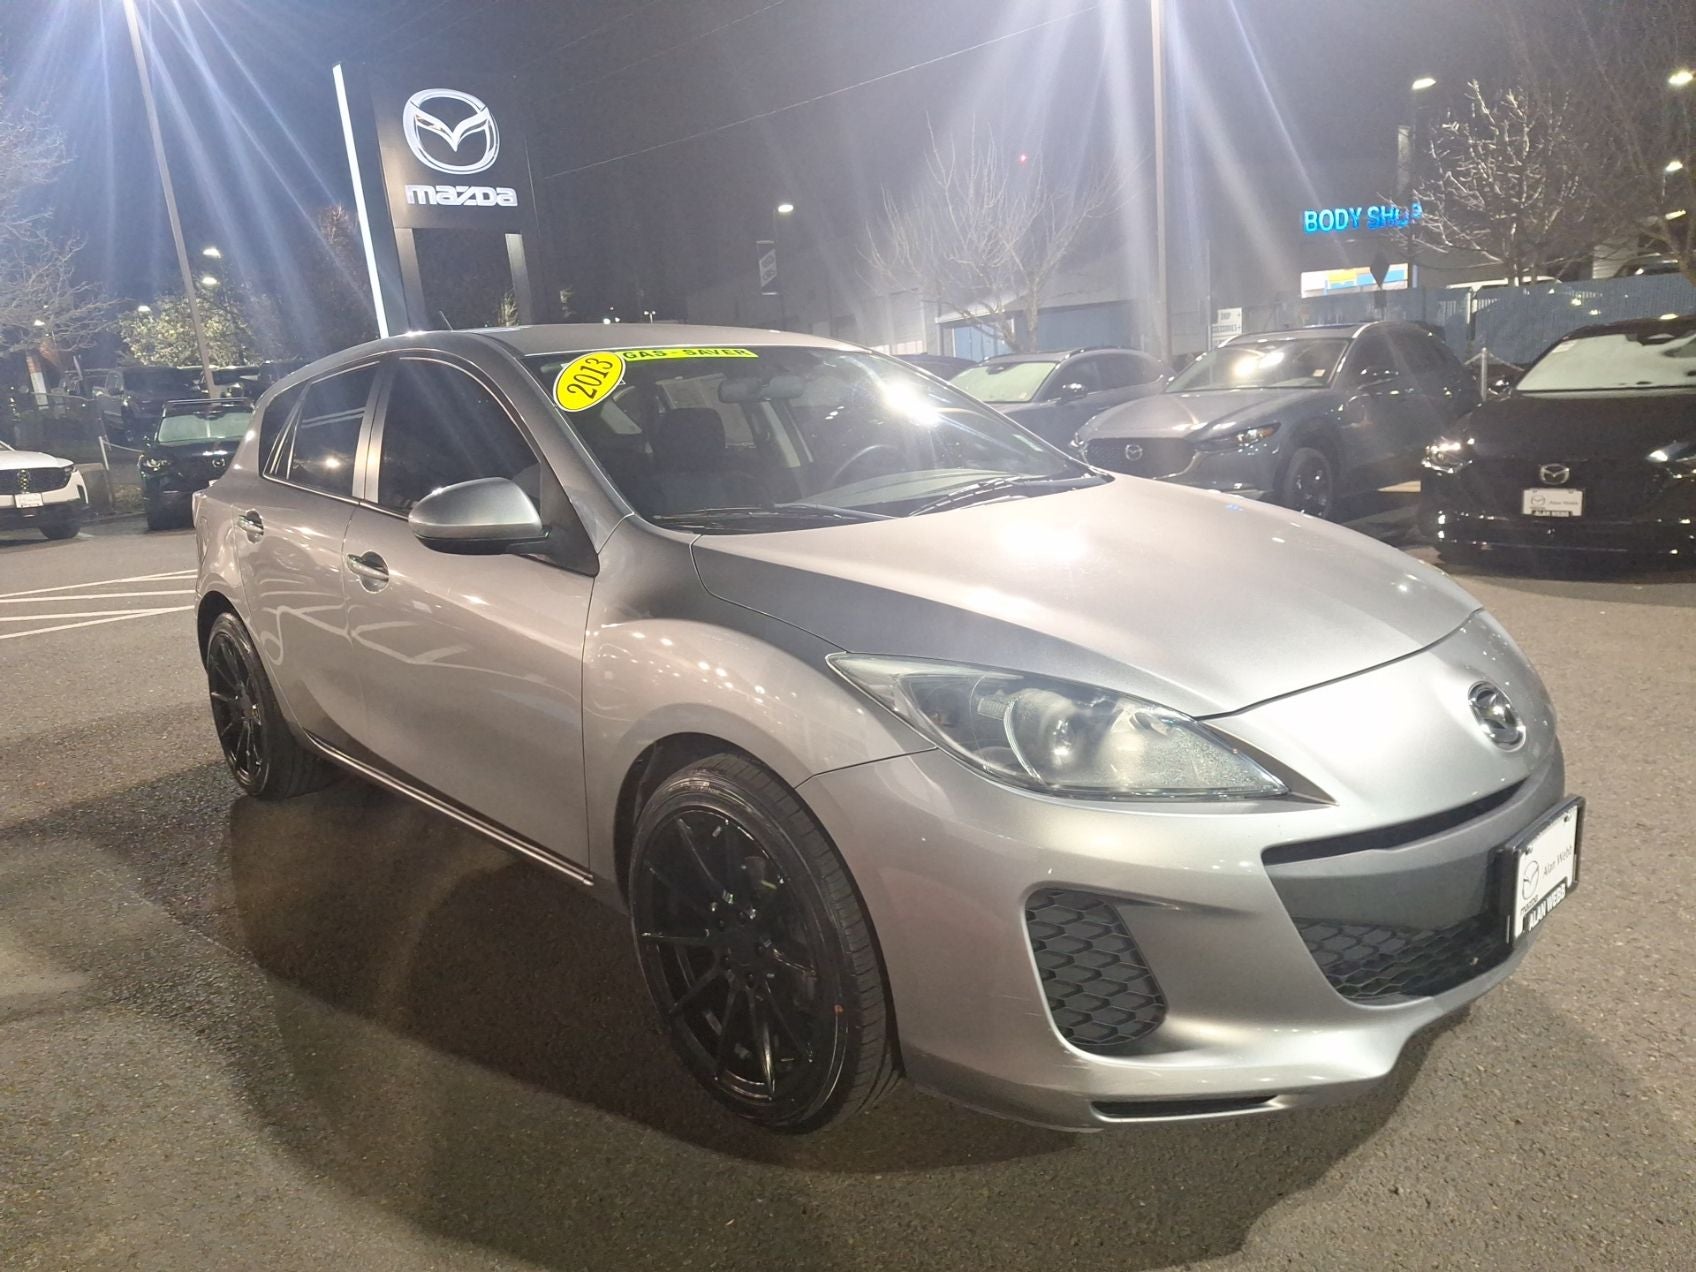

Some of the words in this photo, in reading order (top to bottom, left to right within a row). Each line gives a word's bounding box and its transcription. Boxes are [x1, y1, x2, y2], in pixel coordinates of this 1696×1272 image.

[1303, 207, 1362, 233] BODY
[623, 350, 665, 360] GAS
[683, 349, 751, 357] SAVER
[566, 357, 614, 400] 2013
[1528, 900, 1547, 931] ALAN
[1546, 883, 1566, 912] WEBB
